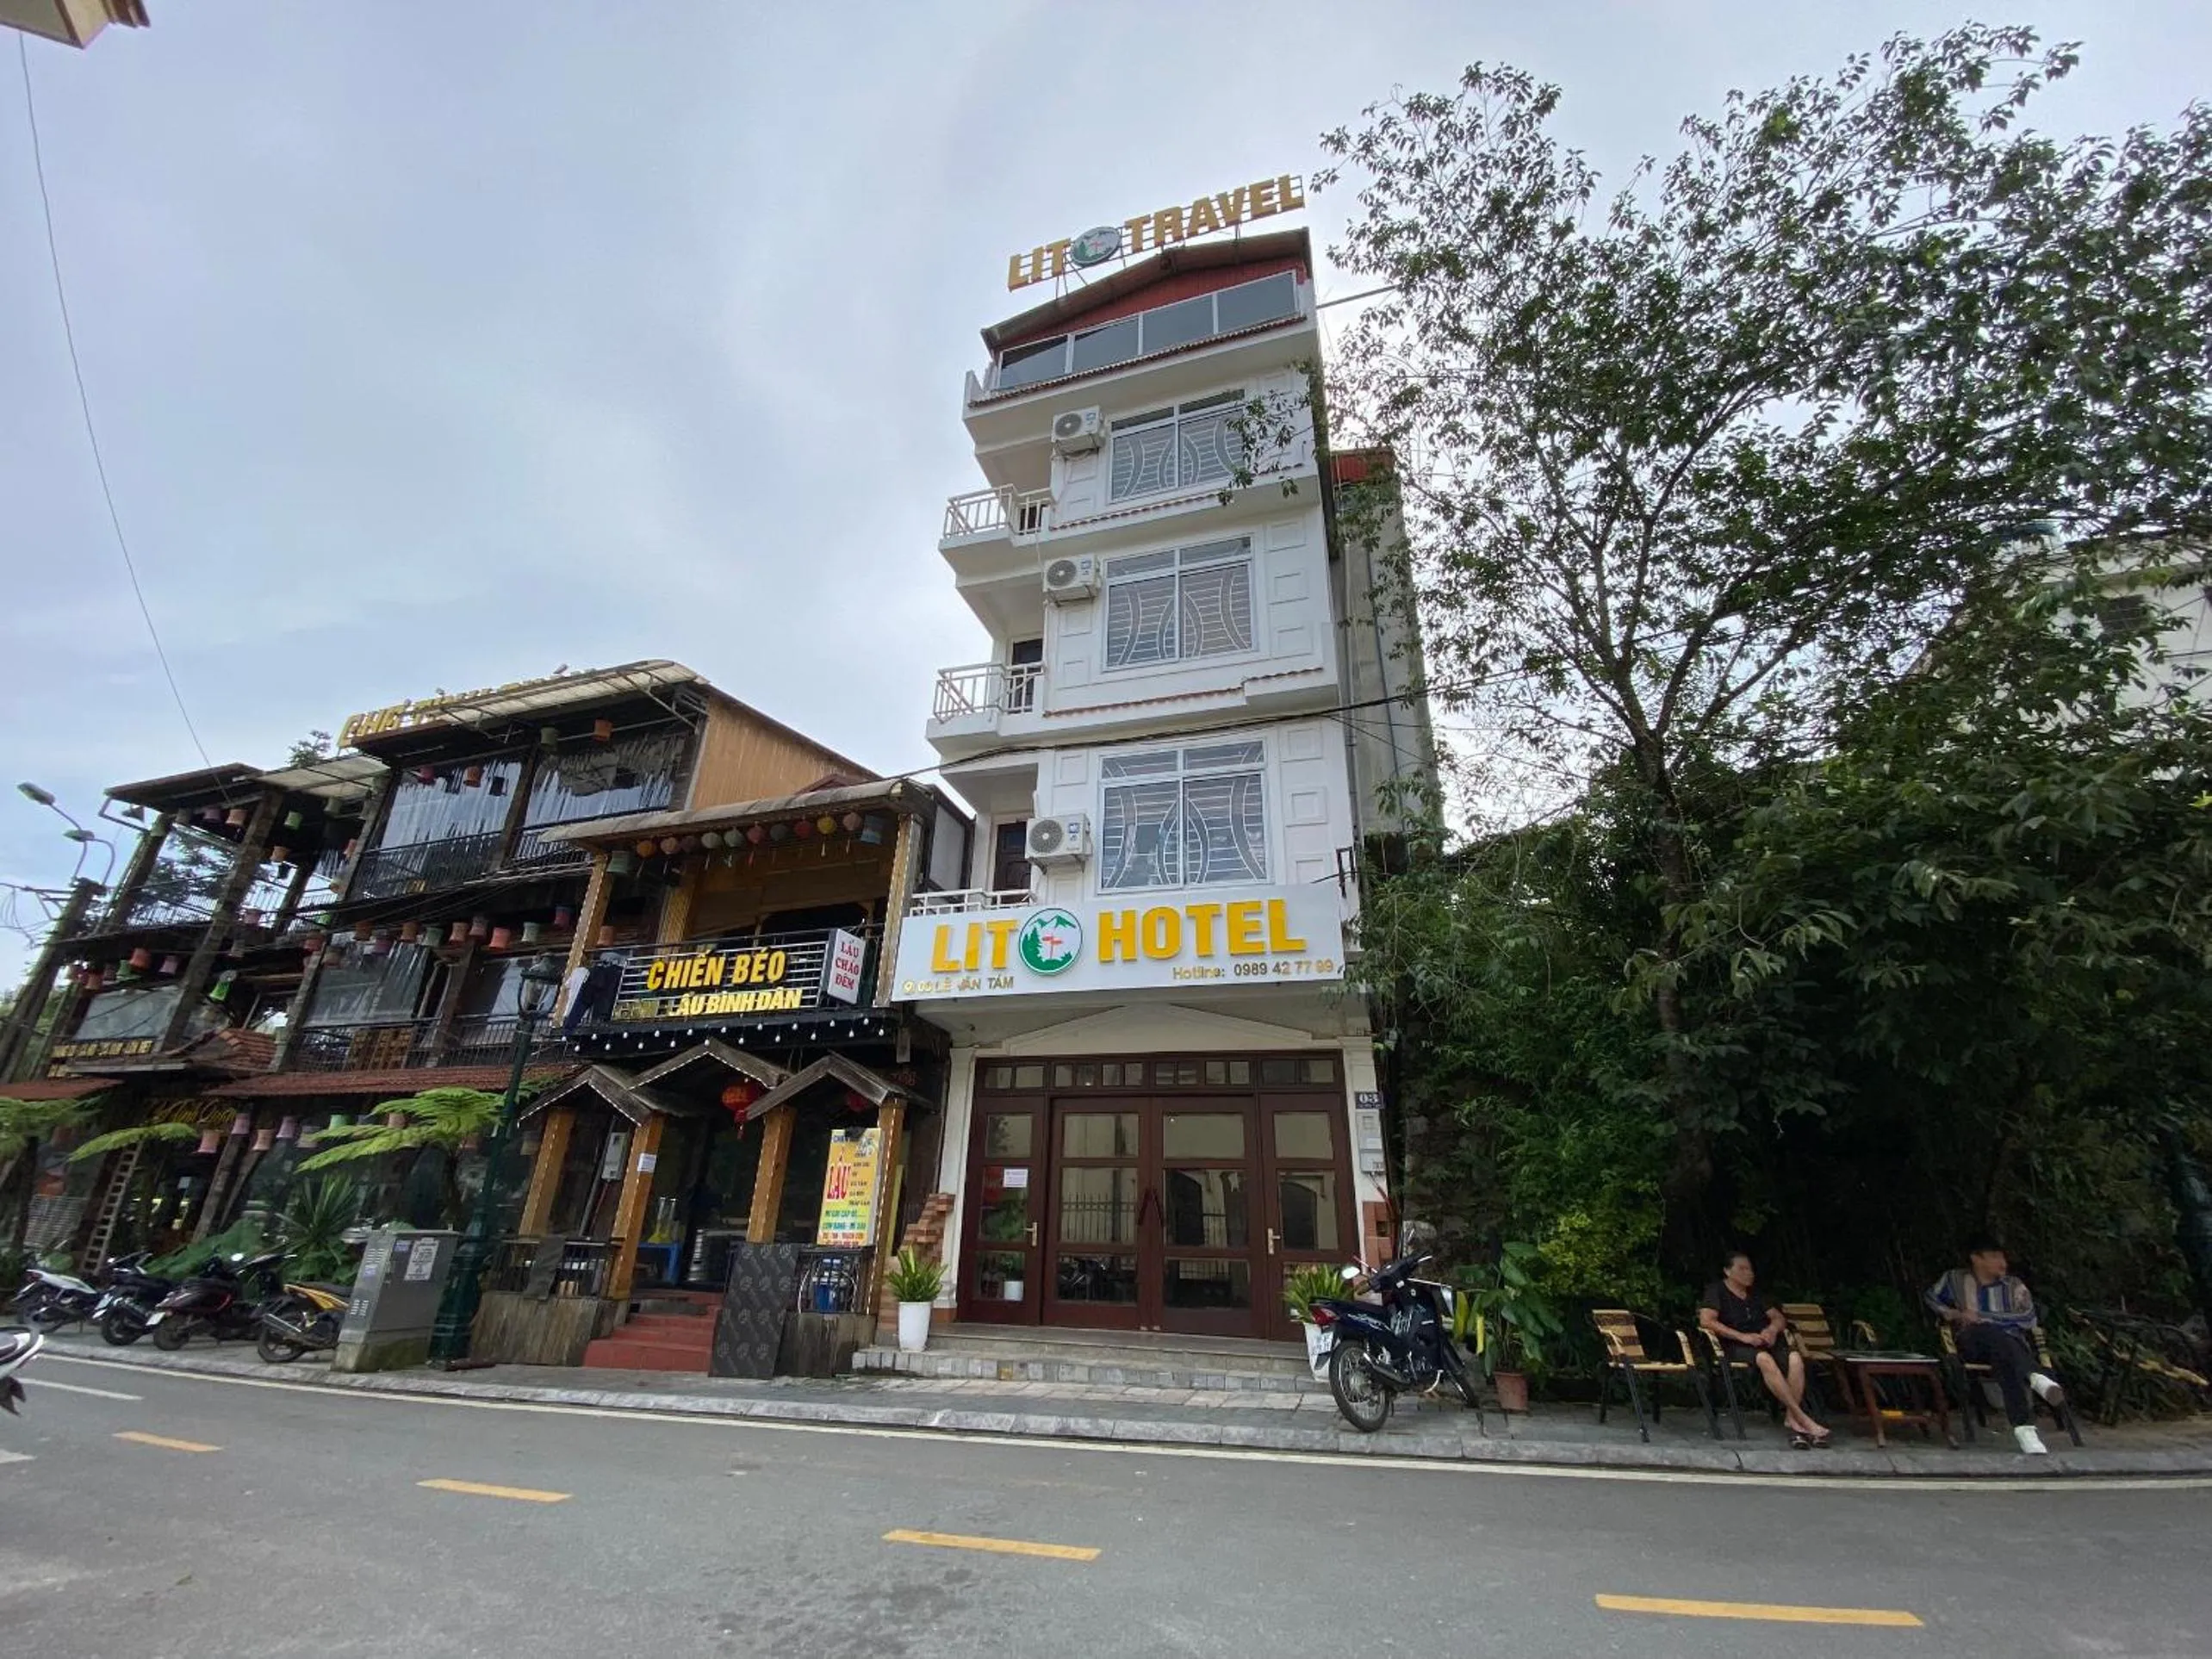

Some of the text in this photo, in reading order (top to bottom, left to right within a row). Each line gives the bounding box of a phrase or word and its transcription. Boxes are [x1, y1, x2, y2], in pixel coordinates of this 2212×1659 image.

[1008, 175, 1305, 292] LIT TRAVEL
[931, 898, 1307, 972] LIT HOTEL
[646, 947, 786, 991] CHIẾN BÉO
[987, 973, 1014, 990] TÁM
[1233, 962, 1267, 977] 0989
[1272, 961, 1291, 975] 42
[1295, 960, 1312, 974] 77
[1358, 1093, 1378, 1103] 03
